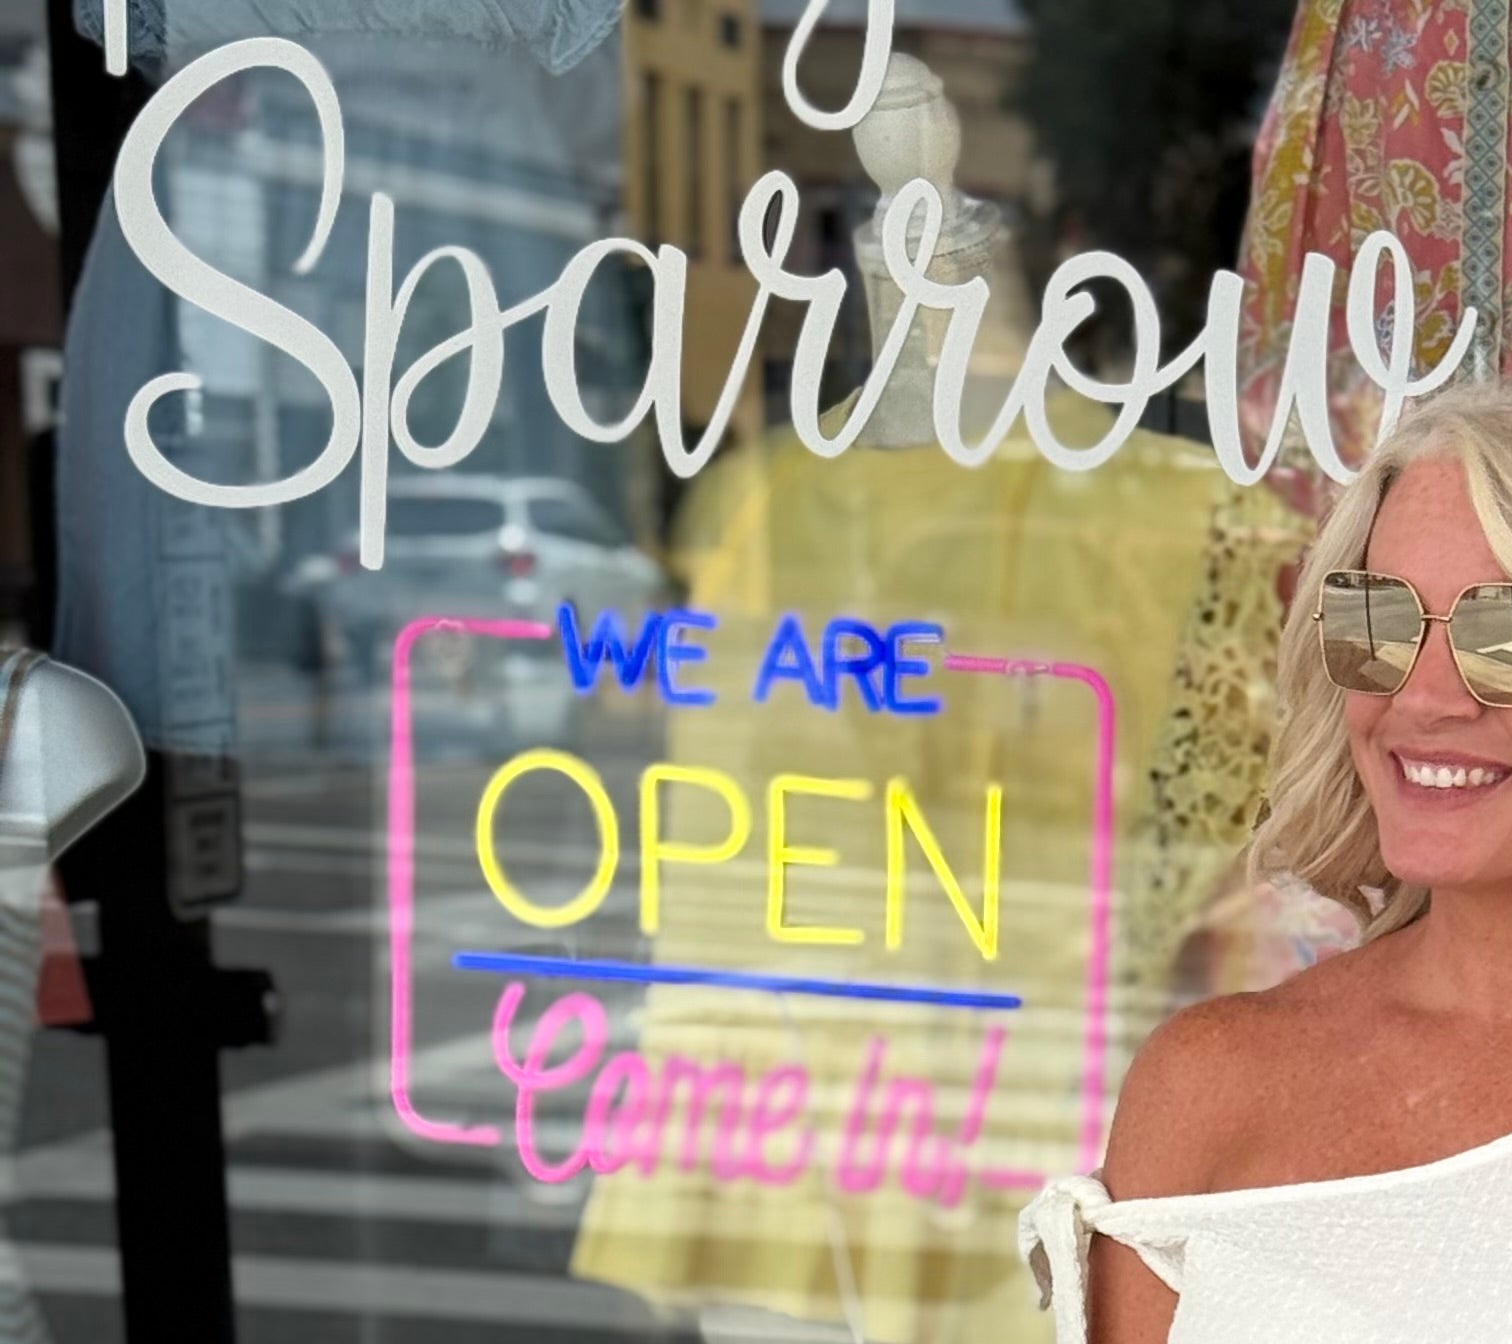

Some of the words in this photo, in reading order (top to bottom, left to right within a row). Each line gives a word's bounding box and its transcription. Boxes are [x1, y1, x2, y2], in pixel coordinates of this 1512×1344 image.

[114, 37, 1478, 571] Sparrow
[557, 599, 717, 707] WE
[753, 614, 944, 716] ARE
[475, 746, 1003, 961] OPEN
[491, 981, 815, 1186] Come
